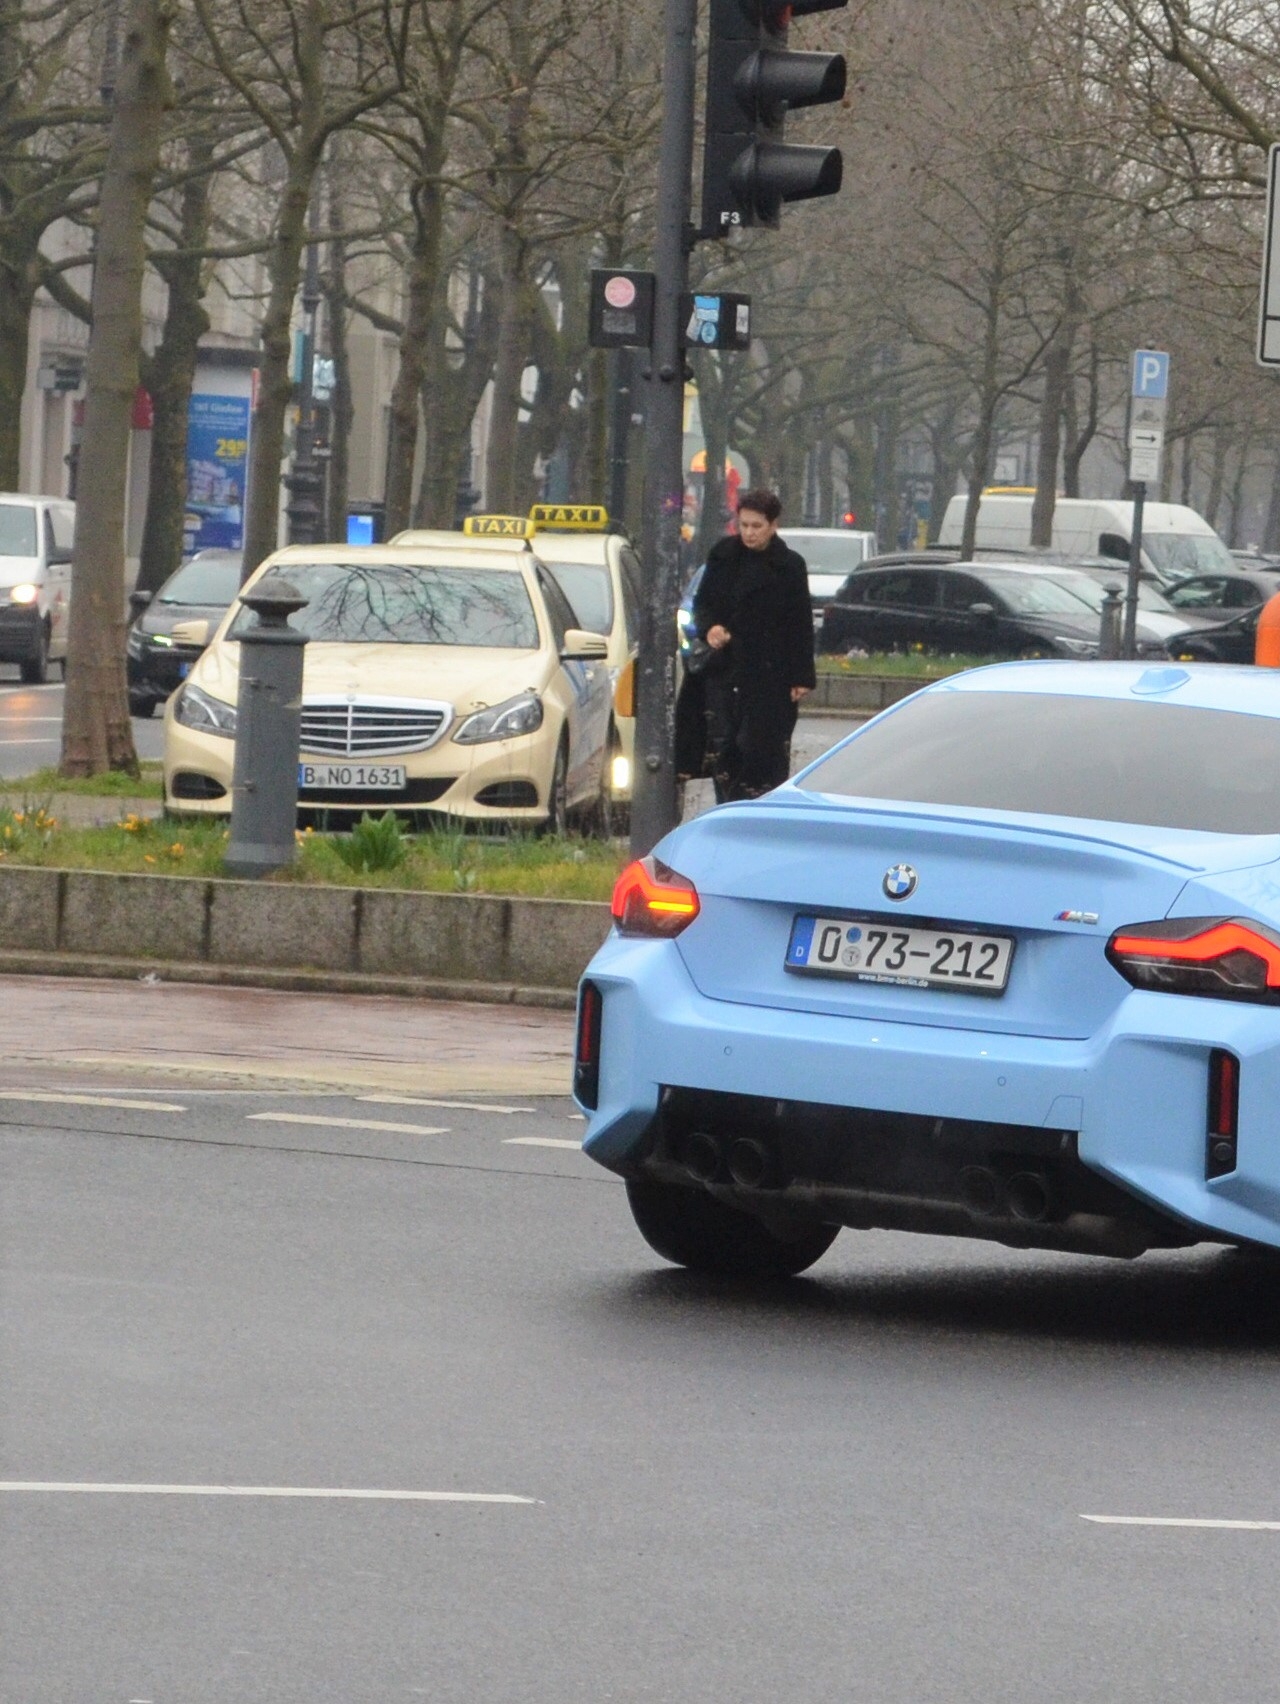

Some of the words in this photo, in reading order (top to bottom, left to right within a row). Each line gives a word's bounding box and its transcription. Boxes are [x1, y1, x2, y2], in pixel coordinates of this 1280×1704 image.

[720, 212, 741, 224] F3
[1141, 356, 1161, 392] P
[541, 508, 593, 521] TAXI
[477, 519, 523, 534] TAXI
[304, 767, 316, 784] B
[328, 767, 352, 785] NO
[356, 768, 401, 786] 1631
[795, 946, 804, 958] D
[865, 930, 1000, 981] 73-212
